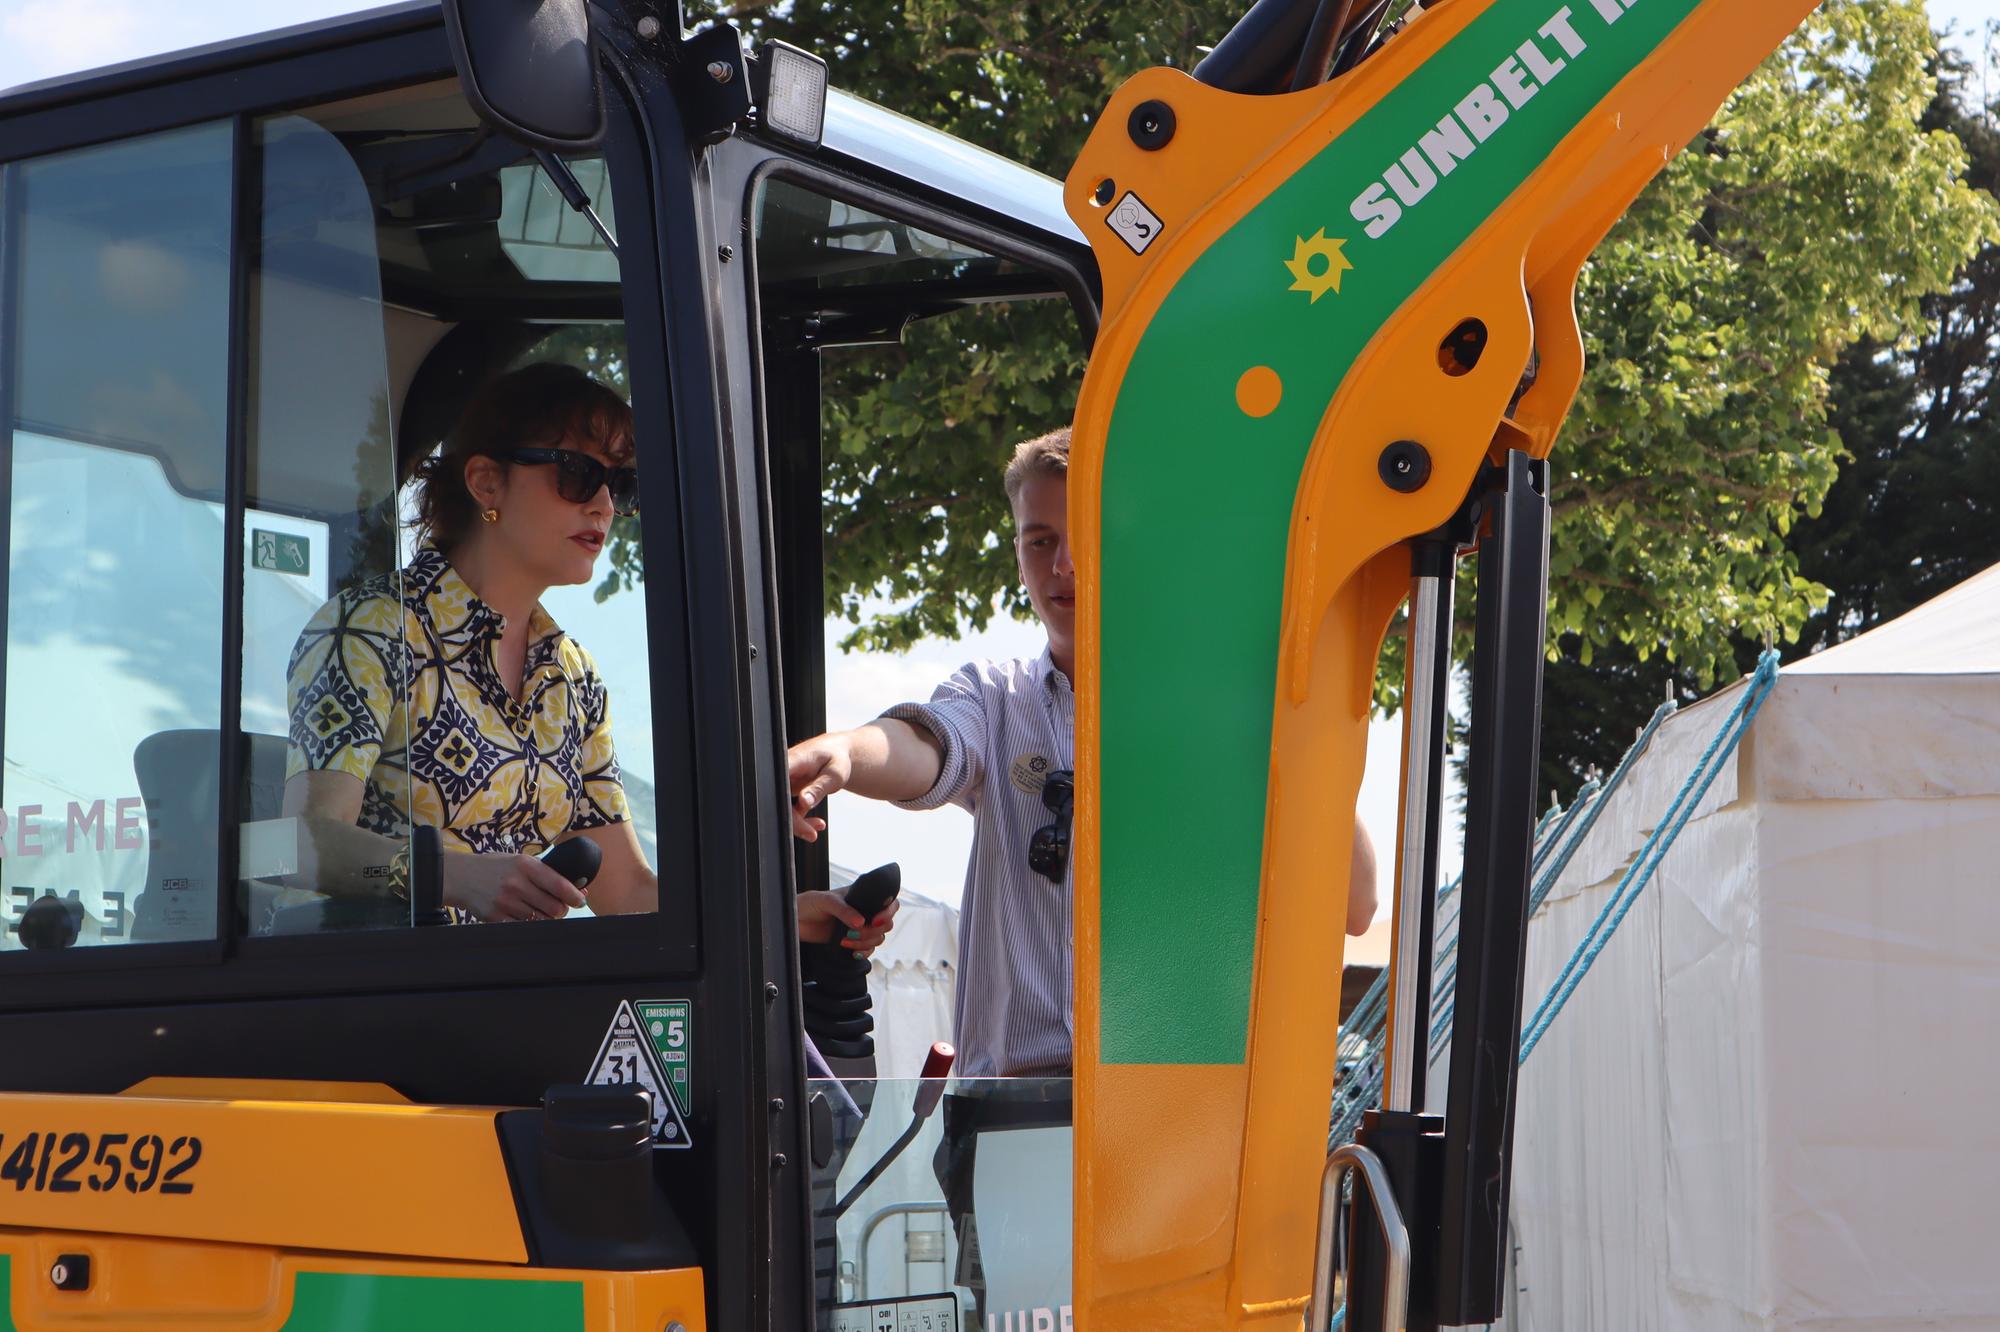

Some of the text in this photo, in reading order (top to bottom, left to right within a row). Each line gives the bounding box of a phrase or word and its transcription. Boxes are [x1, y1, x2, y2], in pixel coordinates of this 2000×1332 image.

[1350, 5, 1587, 239] SUNBELT
[66, 797, 142, 853] ME
[667, 1021, 685, 1047] 5
[608, 1055, 638, 1085] 31
[0, 1133, 202, 1194] 412592
